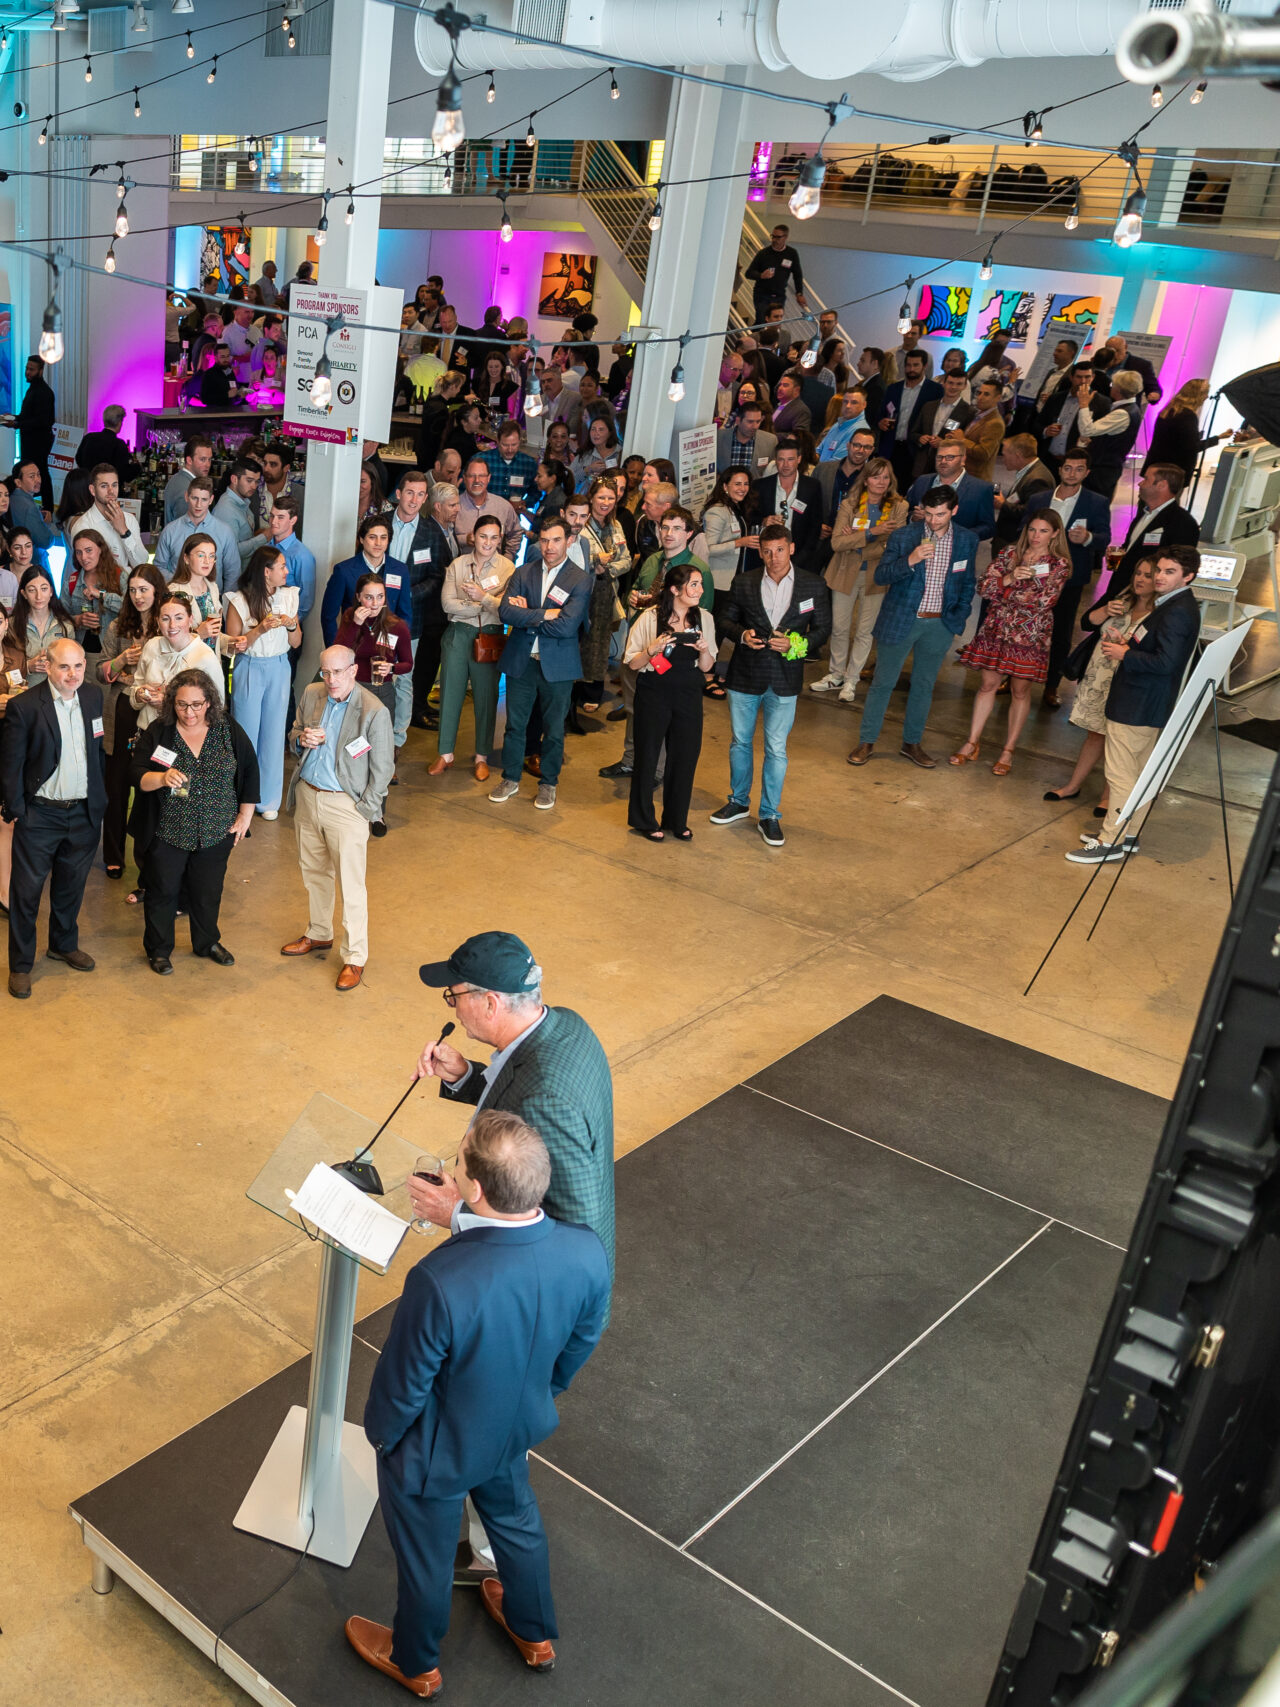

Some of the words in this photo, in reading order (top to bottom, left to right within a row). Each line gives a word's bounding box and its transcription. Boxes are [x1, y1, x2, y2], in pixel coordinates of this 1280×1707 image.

[296, 299, 325, 311] PROGRAM
[327, 302, 359, 315] SPONSORS
[298, 326, 318, 339] PCA
[298, 406, 328, 416] Timberline
[58, 429, 70, 440] BAR
[48, 454, 72, 469] ilbane
